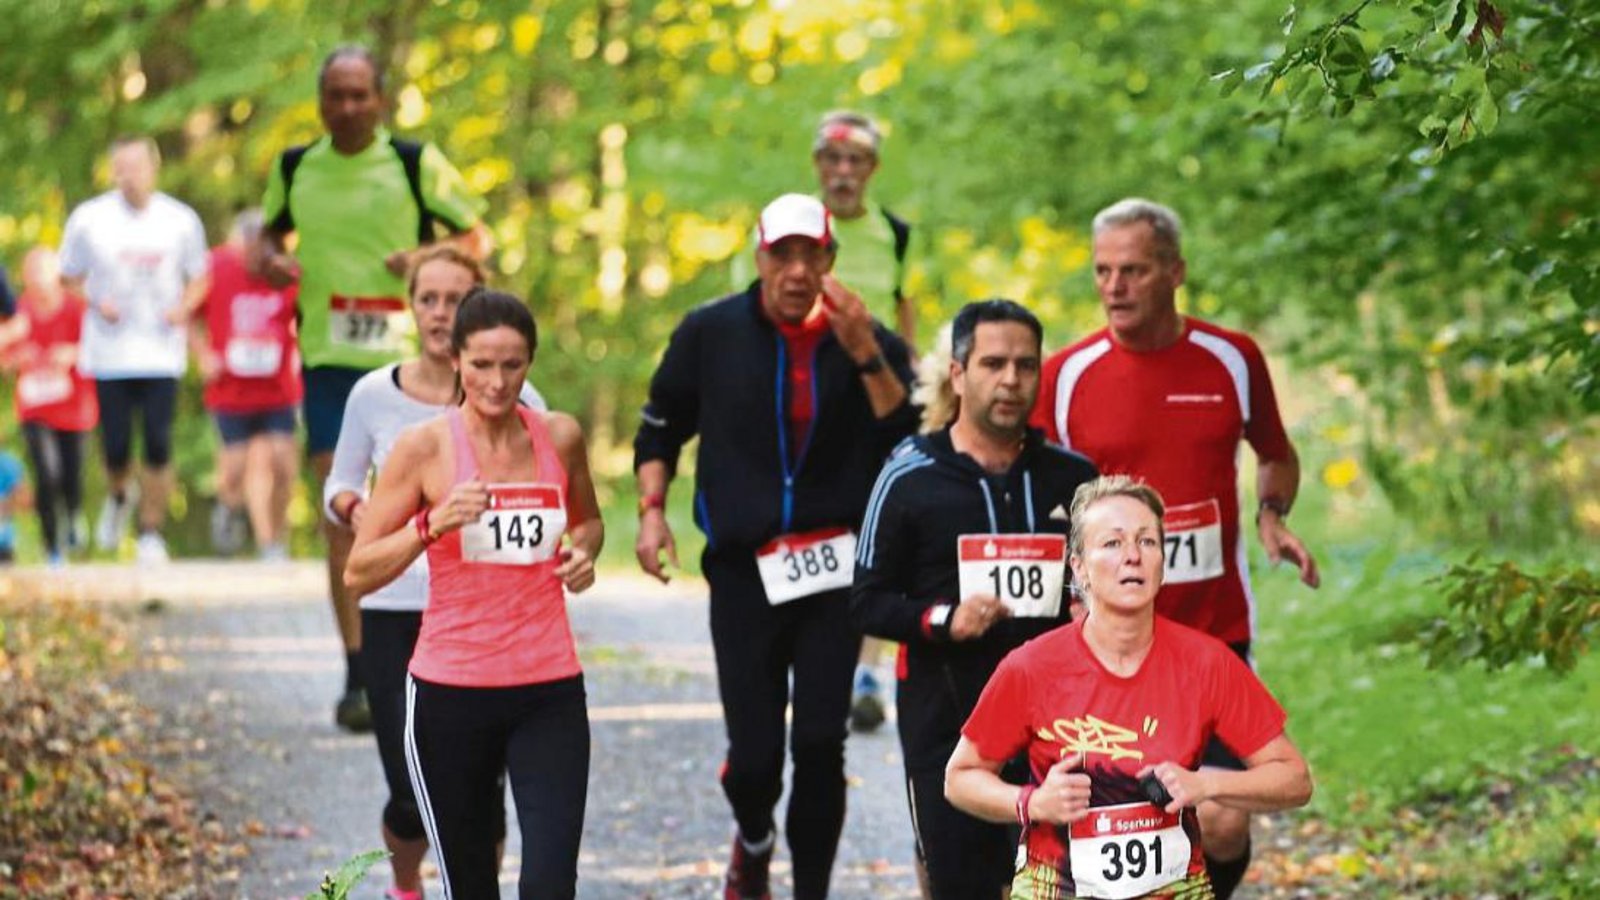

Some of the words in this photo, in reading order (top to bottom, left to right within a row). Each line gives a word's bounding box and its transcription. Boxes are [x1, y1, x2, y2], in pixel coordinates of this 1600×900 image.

[488, 515, 543, 550] 143
[784, 544, 839, 583] 388
[989, 566, 1044, 600] 108
[1101, 835, 1163, 882] 391
